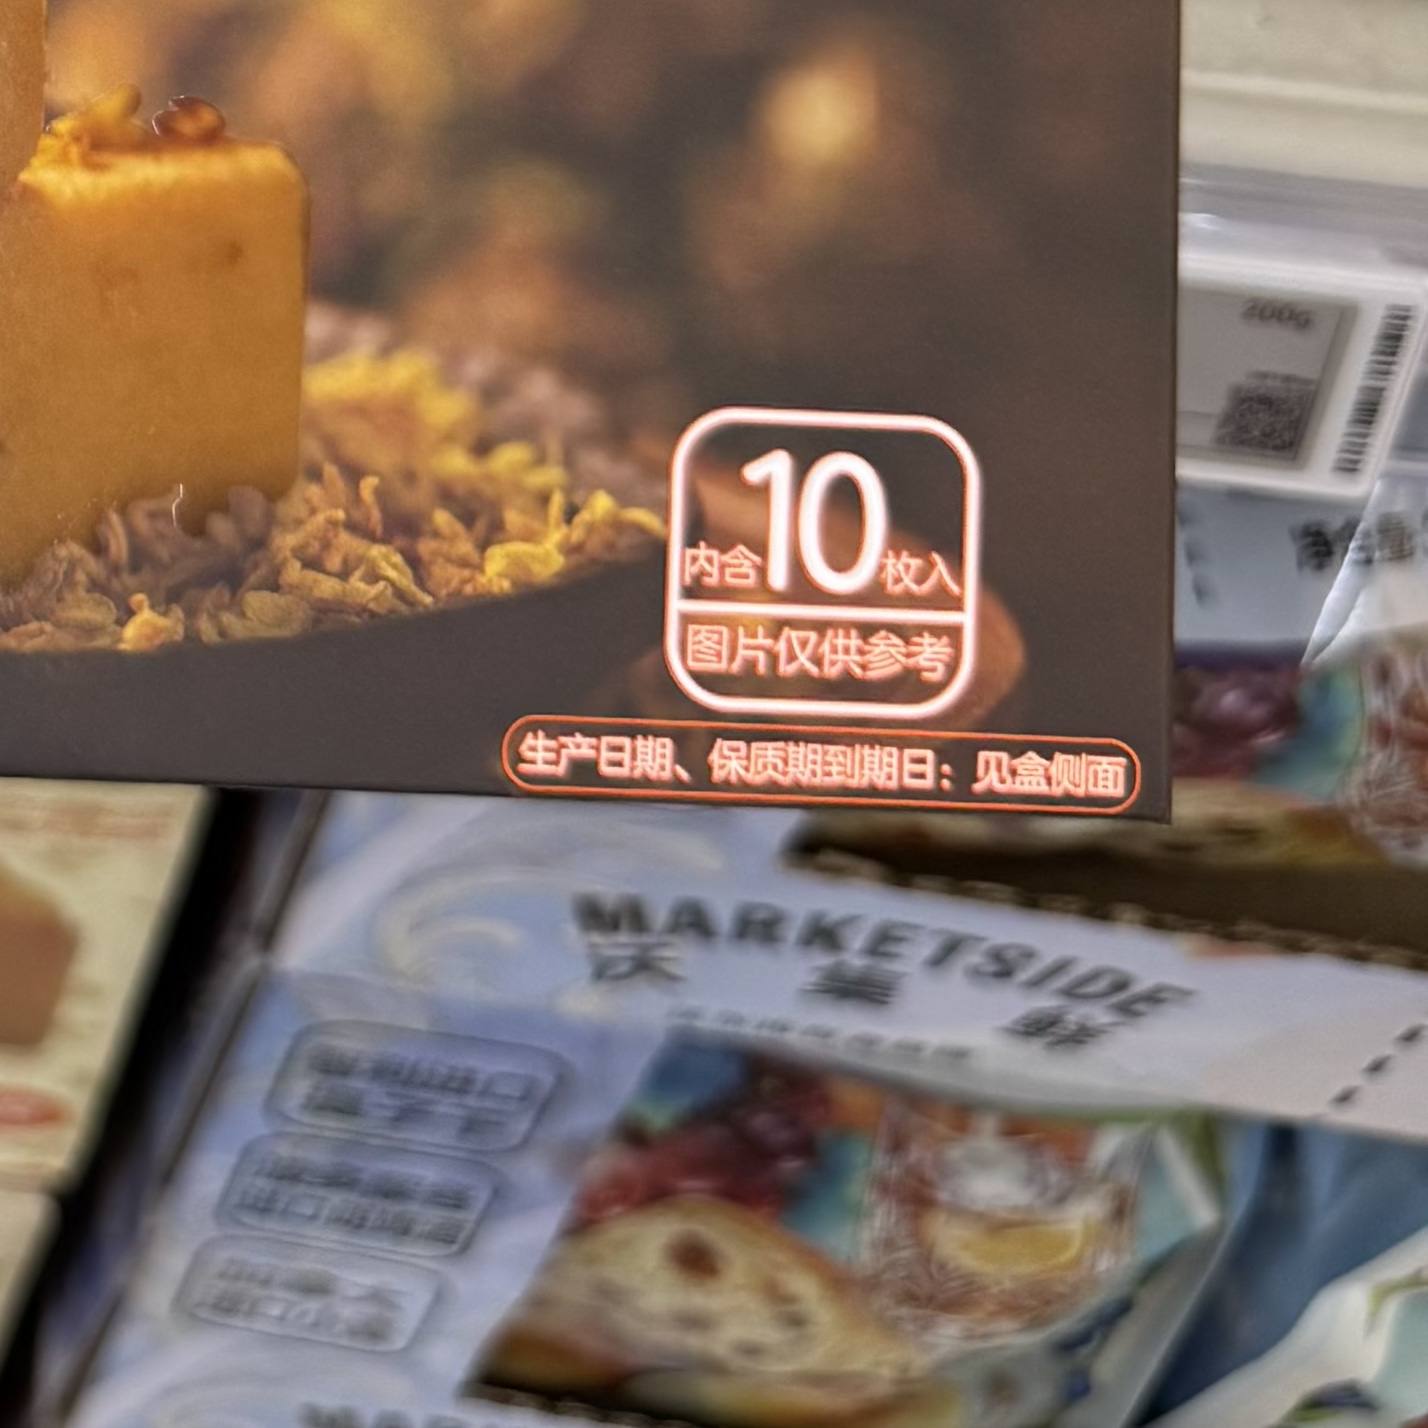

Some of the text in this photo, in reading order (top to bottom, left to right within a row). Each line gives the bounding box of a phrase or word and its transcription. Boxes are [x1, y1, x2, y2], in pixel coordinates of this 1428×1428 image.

[682, 623, 956, 682] 图片仅供参考
[515, 728, 1129, 801] 生产日期、保质期到期日：见盒侧面
[572, 889, 1196, 1020] MARKETSIDE
